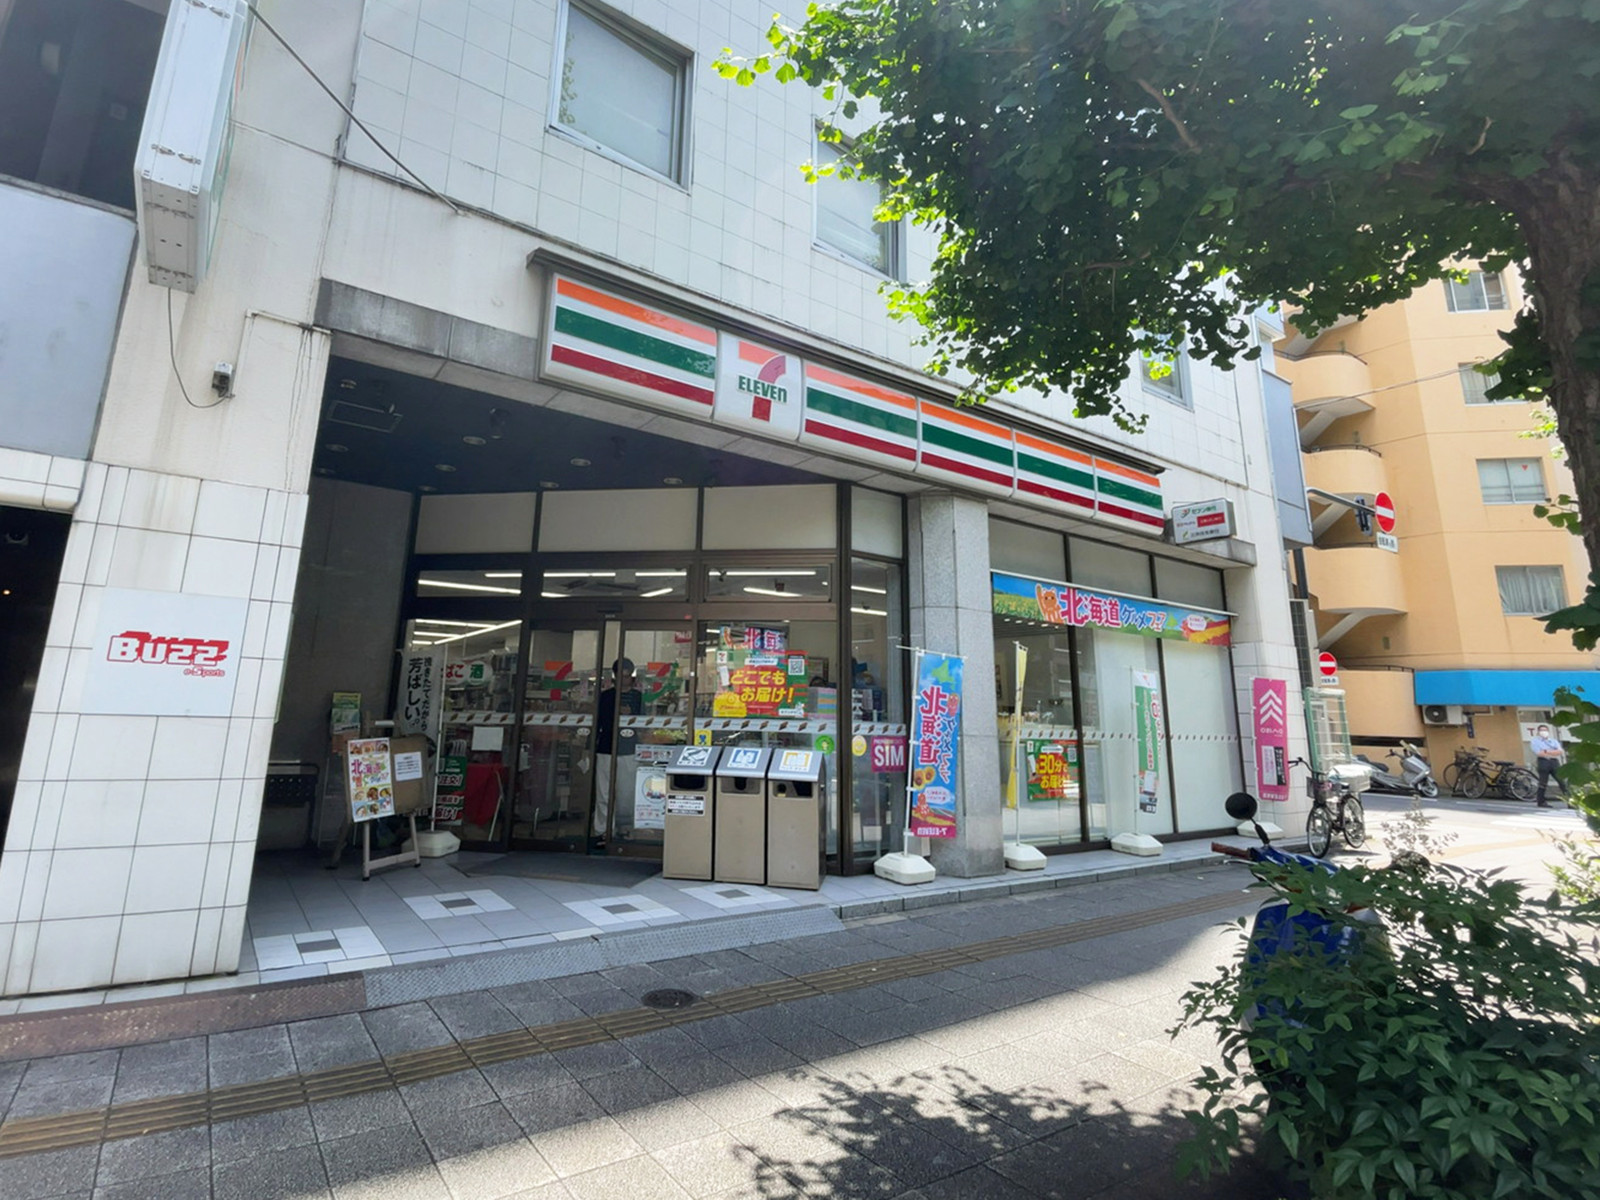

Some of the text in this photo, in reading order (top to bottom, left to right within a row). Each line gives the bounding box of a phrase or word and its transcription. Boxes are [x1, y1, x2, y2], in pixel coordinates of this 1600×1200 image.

[469, 664, 484, 679] 酒
[730, 670, 785, 685] どこでも
[874, 745, 904, 767] SIM
